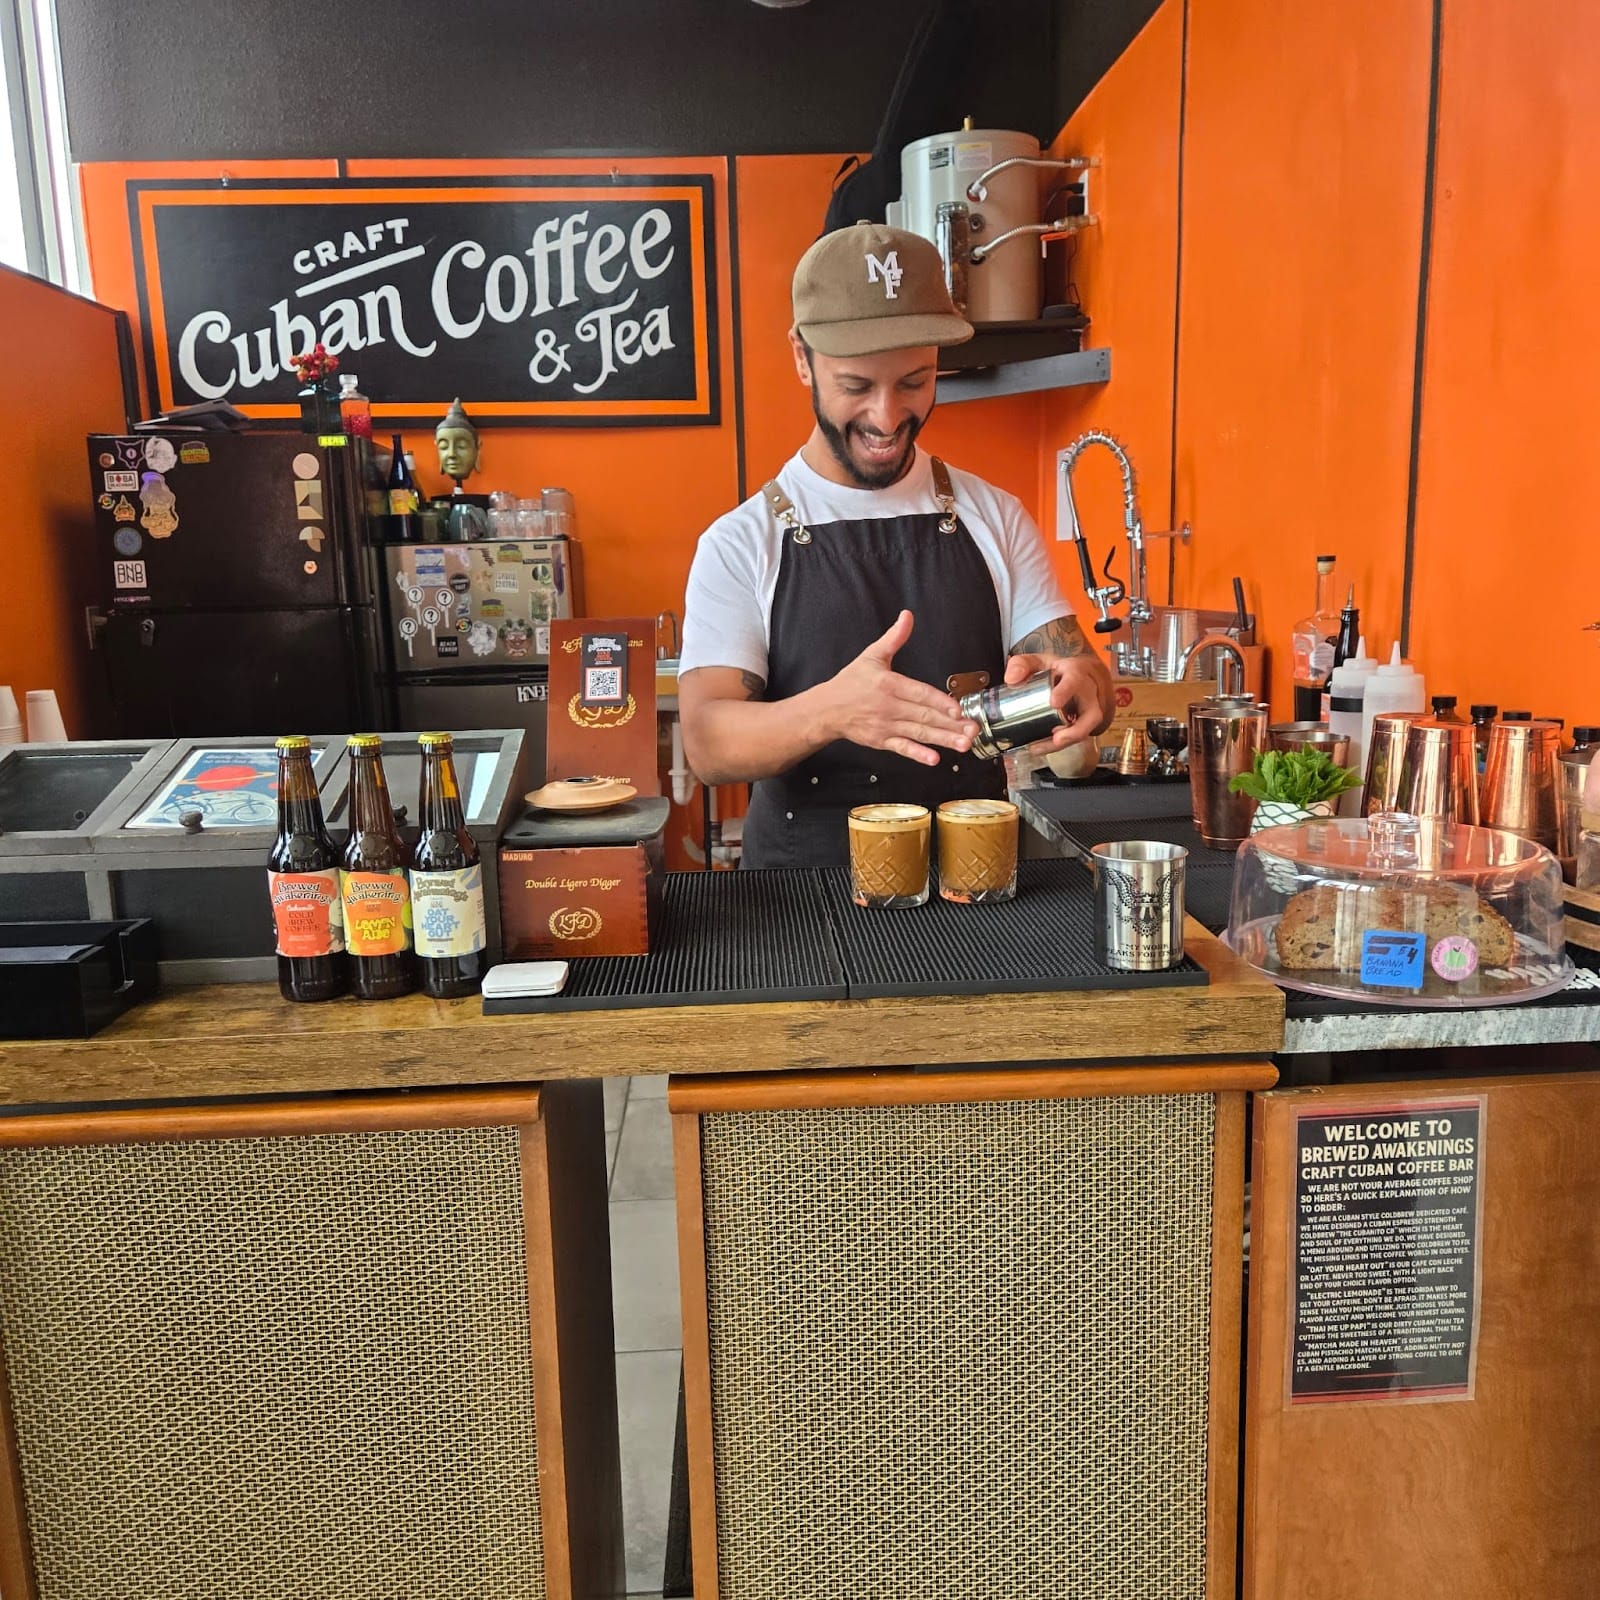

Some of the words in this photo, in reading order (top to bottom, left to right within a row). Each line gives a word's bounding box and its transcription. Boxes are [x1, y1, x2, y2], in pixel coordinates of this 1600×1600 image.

[294, 217, 411, 275] CRAFT
[177, 283, 437, 399] Cuban
[430, 208, 676, 339] Coffee
[528, 328, 572, 384] &
[573, 288, 677, 394] Tea
[502, 853, 534, 861] MADURO
[278, 881, 320, 892] Brewed
[351, 881, 394, 892] Brewed
[525, 876, 557, 889] Double
[559, 878, 588, 892] Ligero
[590, 877, 621, 891] Digger
[275, 890, 331, 904] Awakenings
[427, 908, 449, 916] OAT
[424, 915, 455, 925] YOUR
[421, 921, 460, 931] HEART
[428, 929, 451, 937] OUT
[1366, 958, 1405, 969] BANANA
[1365, 967, 1402, 976] BREAD
[1324, 1121, 1420, 1142] WELCOME
[1425, 1119, 1451, 1136] TO
[1301, 1143, 1369, 1163] BREWED
[1371, 1138, 1474, 1159] AWAKENINGS
[1301, 1165, 1345, 1180] CRAFT
[1347, 1162, 1393, 1177] CUBAN
[1396, 1159, 1445, 1174] COFFEE
[1448, 1158, 1473, 1172] BAR
[1307, 1184, 1321, 1193] WE
[1322, 1183, 1339, 1192] ARE
[1341, 1182, 1358, 1191] NOT
[1359, 1180, 1382, 1190] YOUR
[1383, 1178, 1421, 1188] AVERAGE
[1422, 1177, 1451, 1186] COFFEE
[1452, 1176, 1473, 1185] SHOP
[1300, 1194, 1312, 1203] SO
[1313, 1192, 1341, 1202] HERE'S
[1343, 1192, 1350, 1200] A
[1351, 1190, 1377, 1200] QUICK
[1379, 1187, 1435, 1198] EXPLANATION
[1437, 1186, 1448, 1195] OF
[1450, 1185, 1470, 1194] HOW
[1300, 1204, 1312, 1213] TO
[1313, 1202, 1345, 1212] ORDER:
[1380, 1210, 1414, 1219] COLDBREW
[1416, 1208, 1450, 1217] DEDICATED
[1330, 1221, 1362, 1229] DESIGNED
[1392, 1218, 1423, 1226] ESPRESSO
[1424, 1216, 1456, 1224] STRENGTH
[1300, 1230, 1335, 1239] COLDBREW
[1352, 1228, 1385, 1236] CUBANITO
[1343, 1236, 1382, 1245] EVERYTHING
[1435, 1231, 1465, 1239] DESIGNED
[1326, 1245, 1353, 1254] AROUND
[1369, 1242, 1400, 1251] UTILIZING
[1416, 1240, 1450, 1248] COLDBREW
[1313, 1254, 1340, 1262] MISSING
[1324, 1264, 1344, 1272] YOUR
[1345, 1262, 1369, 1271] HEART
[1443, 1257, 1462, 1265] LECHE
[1342, 1279, 1366, 1287] CHOICE
[1367, 1277, 1391, 1285] FLAVOR
[1407, 1285, 1433, 1293] FLORIDA
